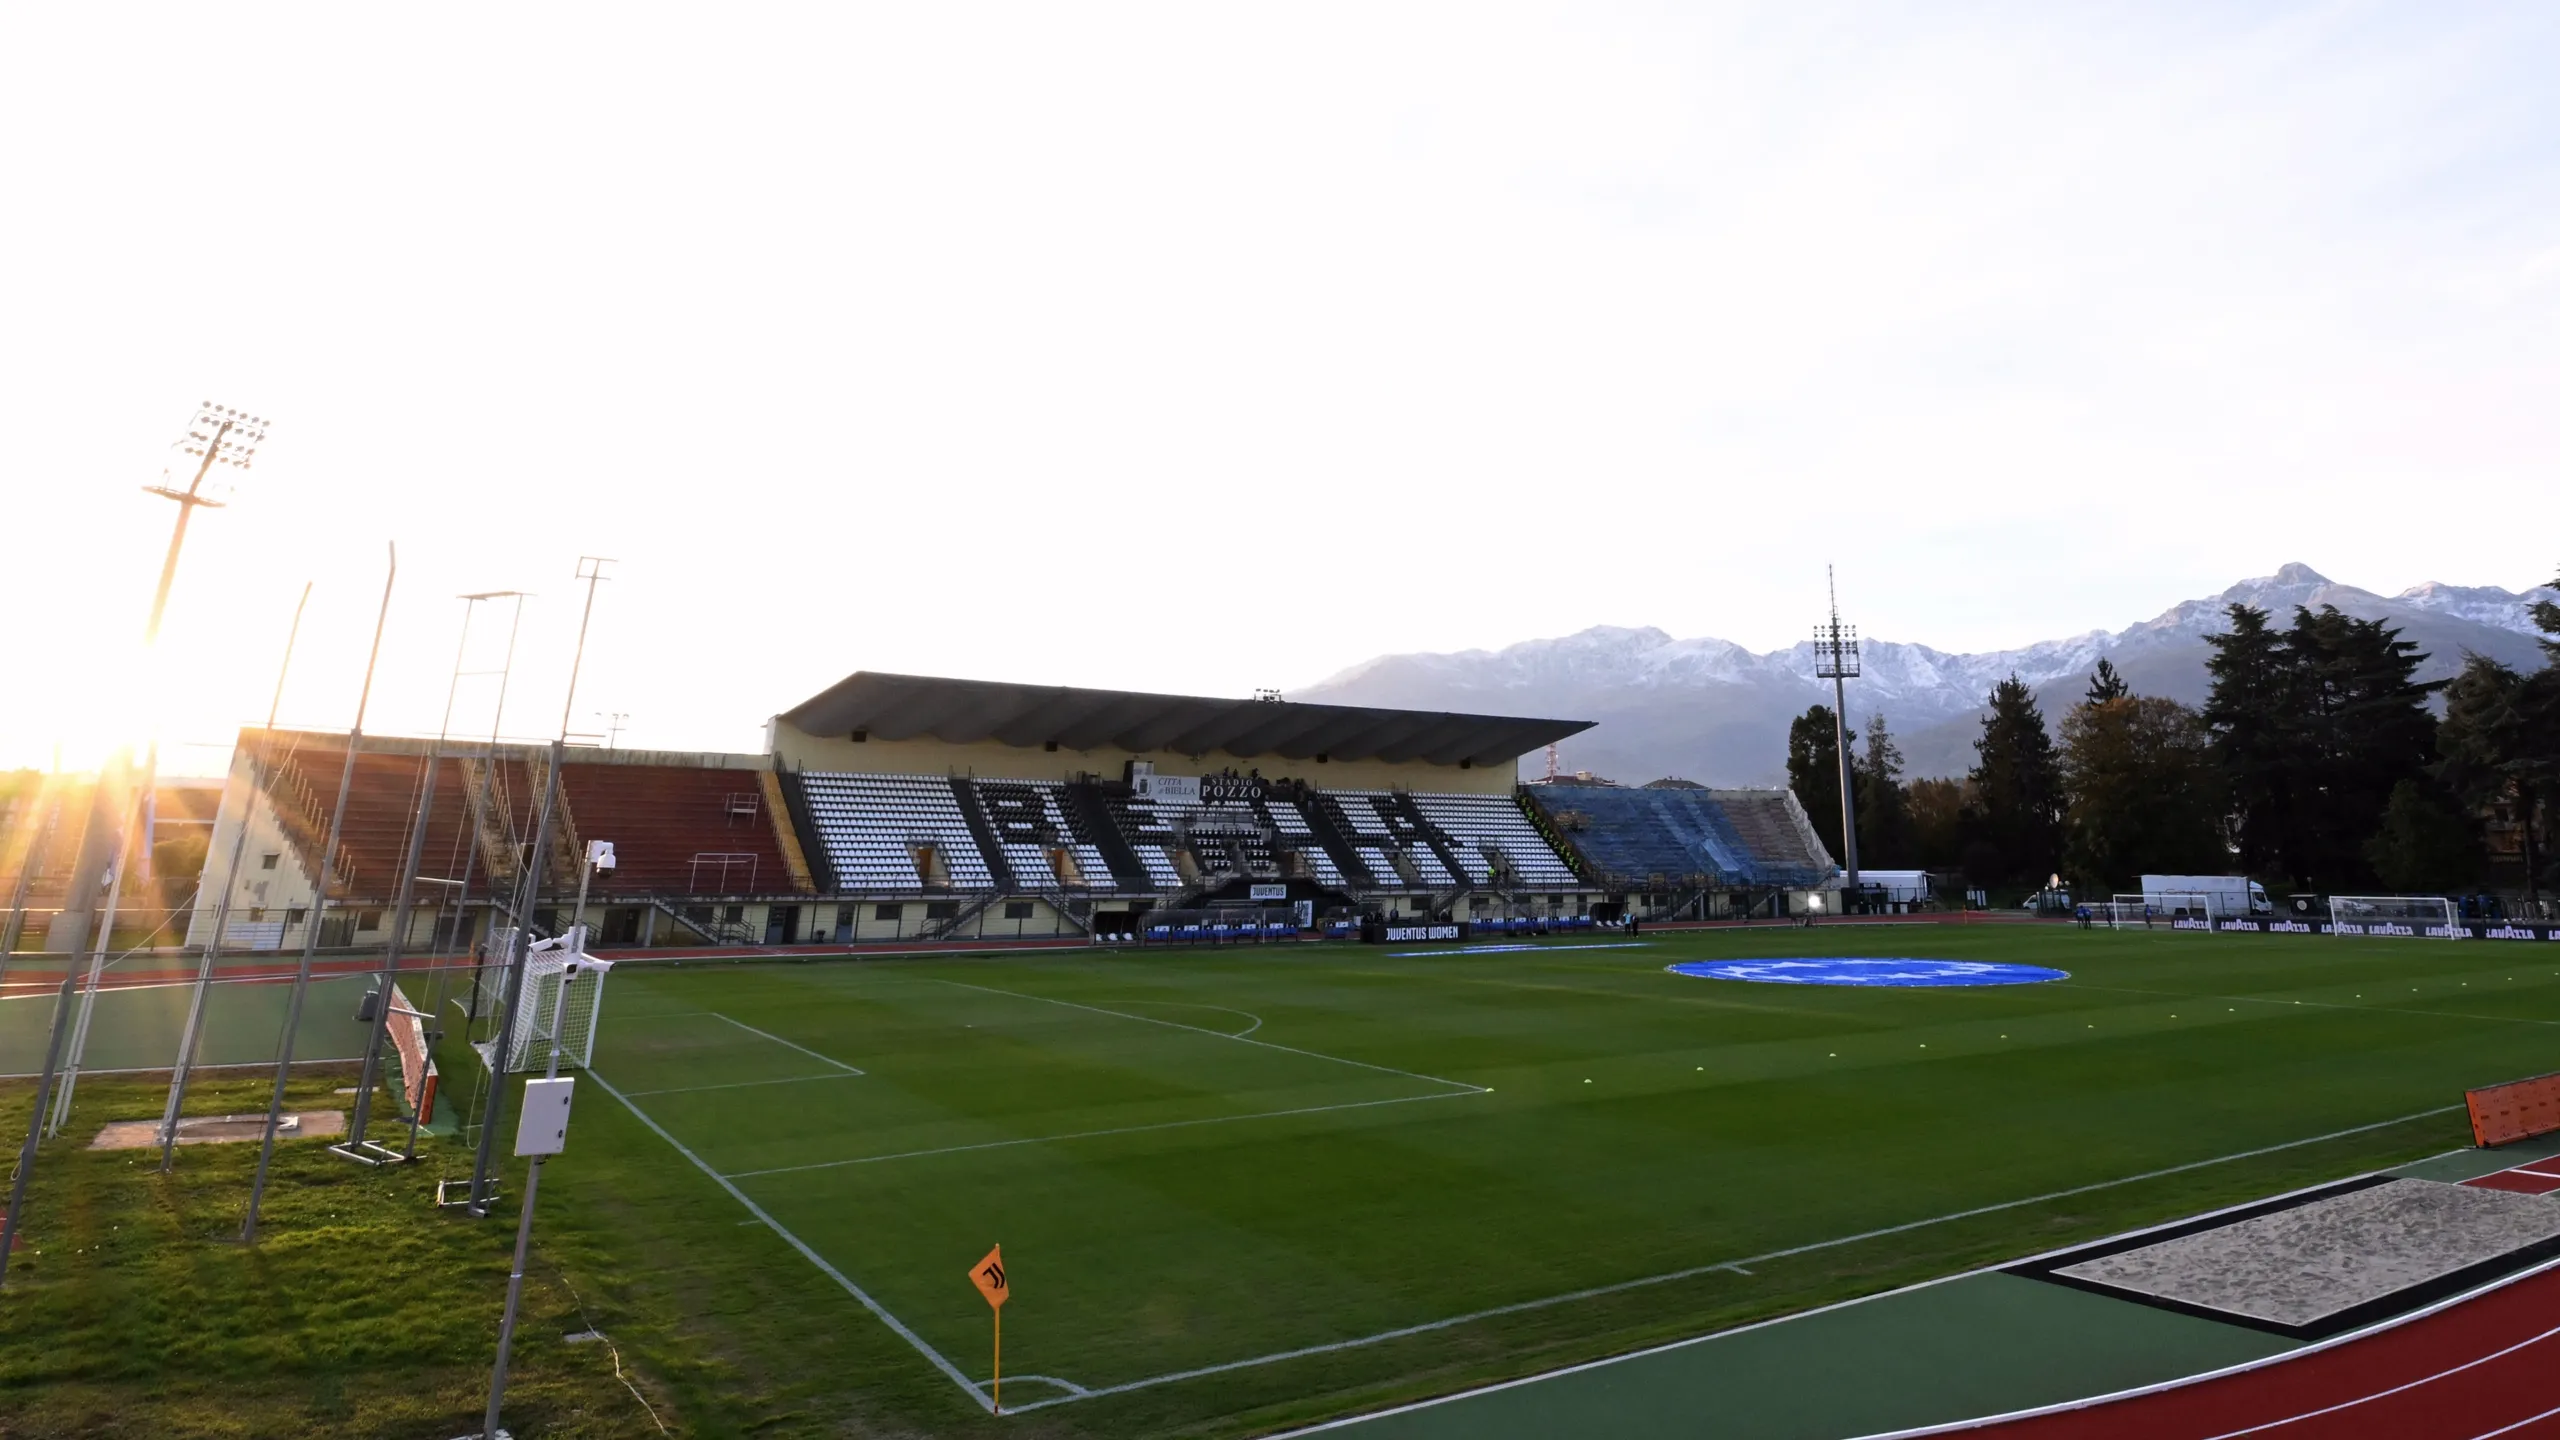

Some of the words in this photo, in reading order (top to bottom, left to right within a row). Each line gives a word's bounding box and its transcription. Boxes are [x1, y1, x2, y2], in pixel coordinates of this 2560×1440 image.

[1165, 787, 1195, 796] BIELLA
[1202, 786, 1261, 798] POZZO
[1252, 887, 1284, 897] JUVENTUS
[2220, 918, 2260, 931] LAVAZZA
[2269, 920, 2311, 933] LAVAZZA
[2368, 922, 2413, 936] LAVAZZA
[1386, 927, 1427, 941] JUVENTUS
[1428, 926, 1459, 940] WOMEN
[2486, 926, 2536, 940] LAVAZZA
